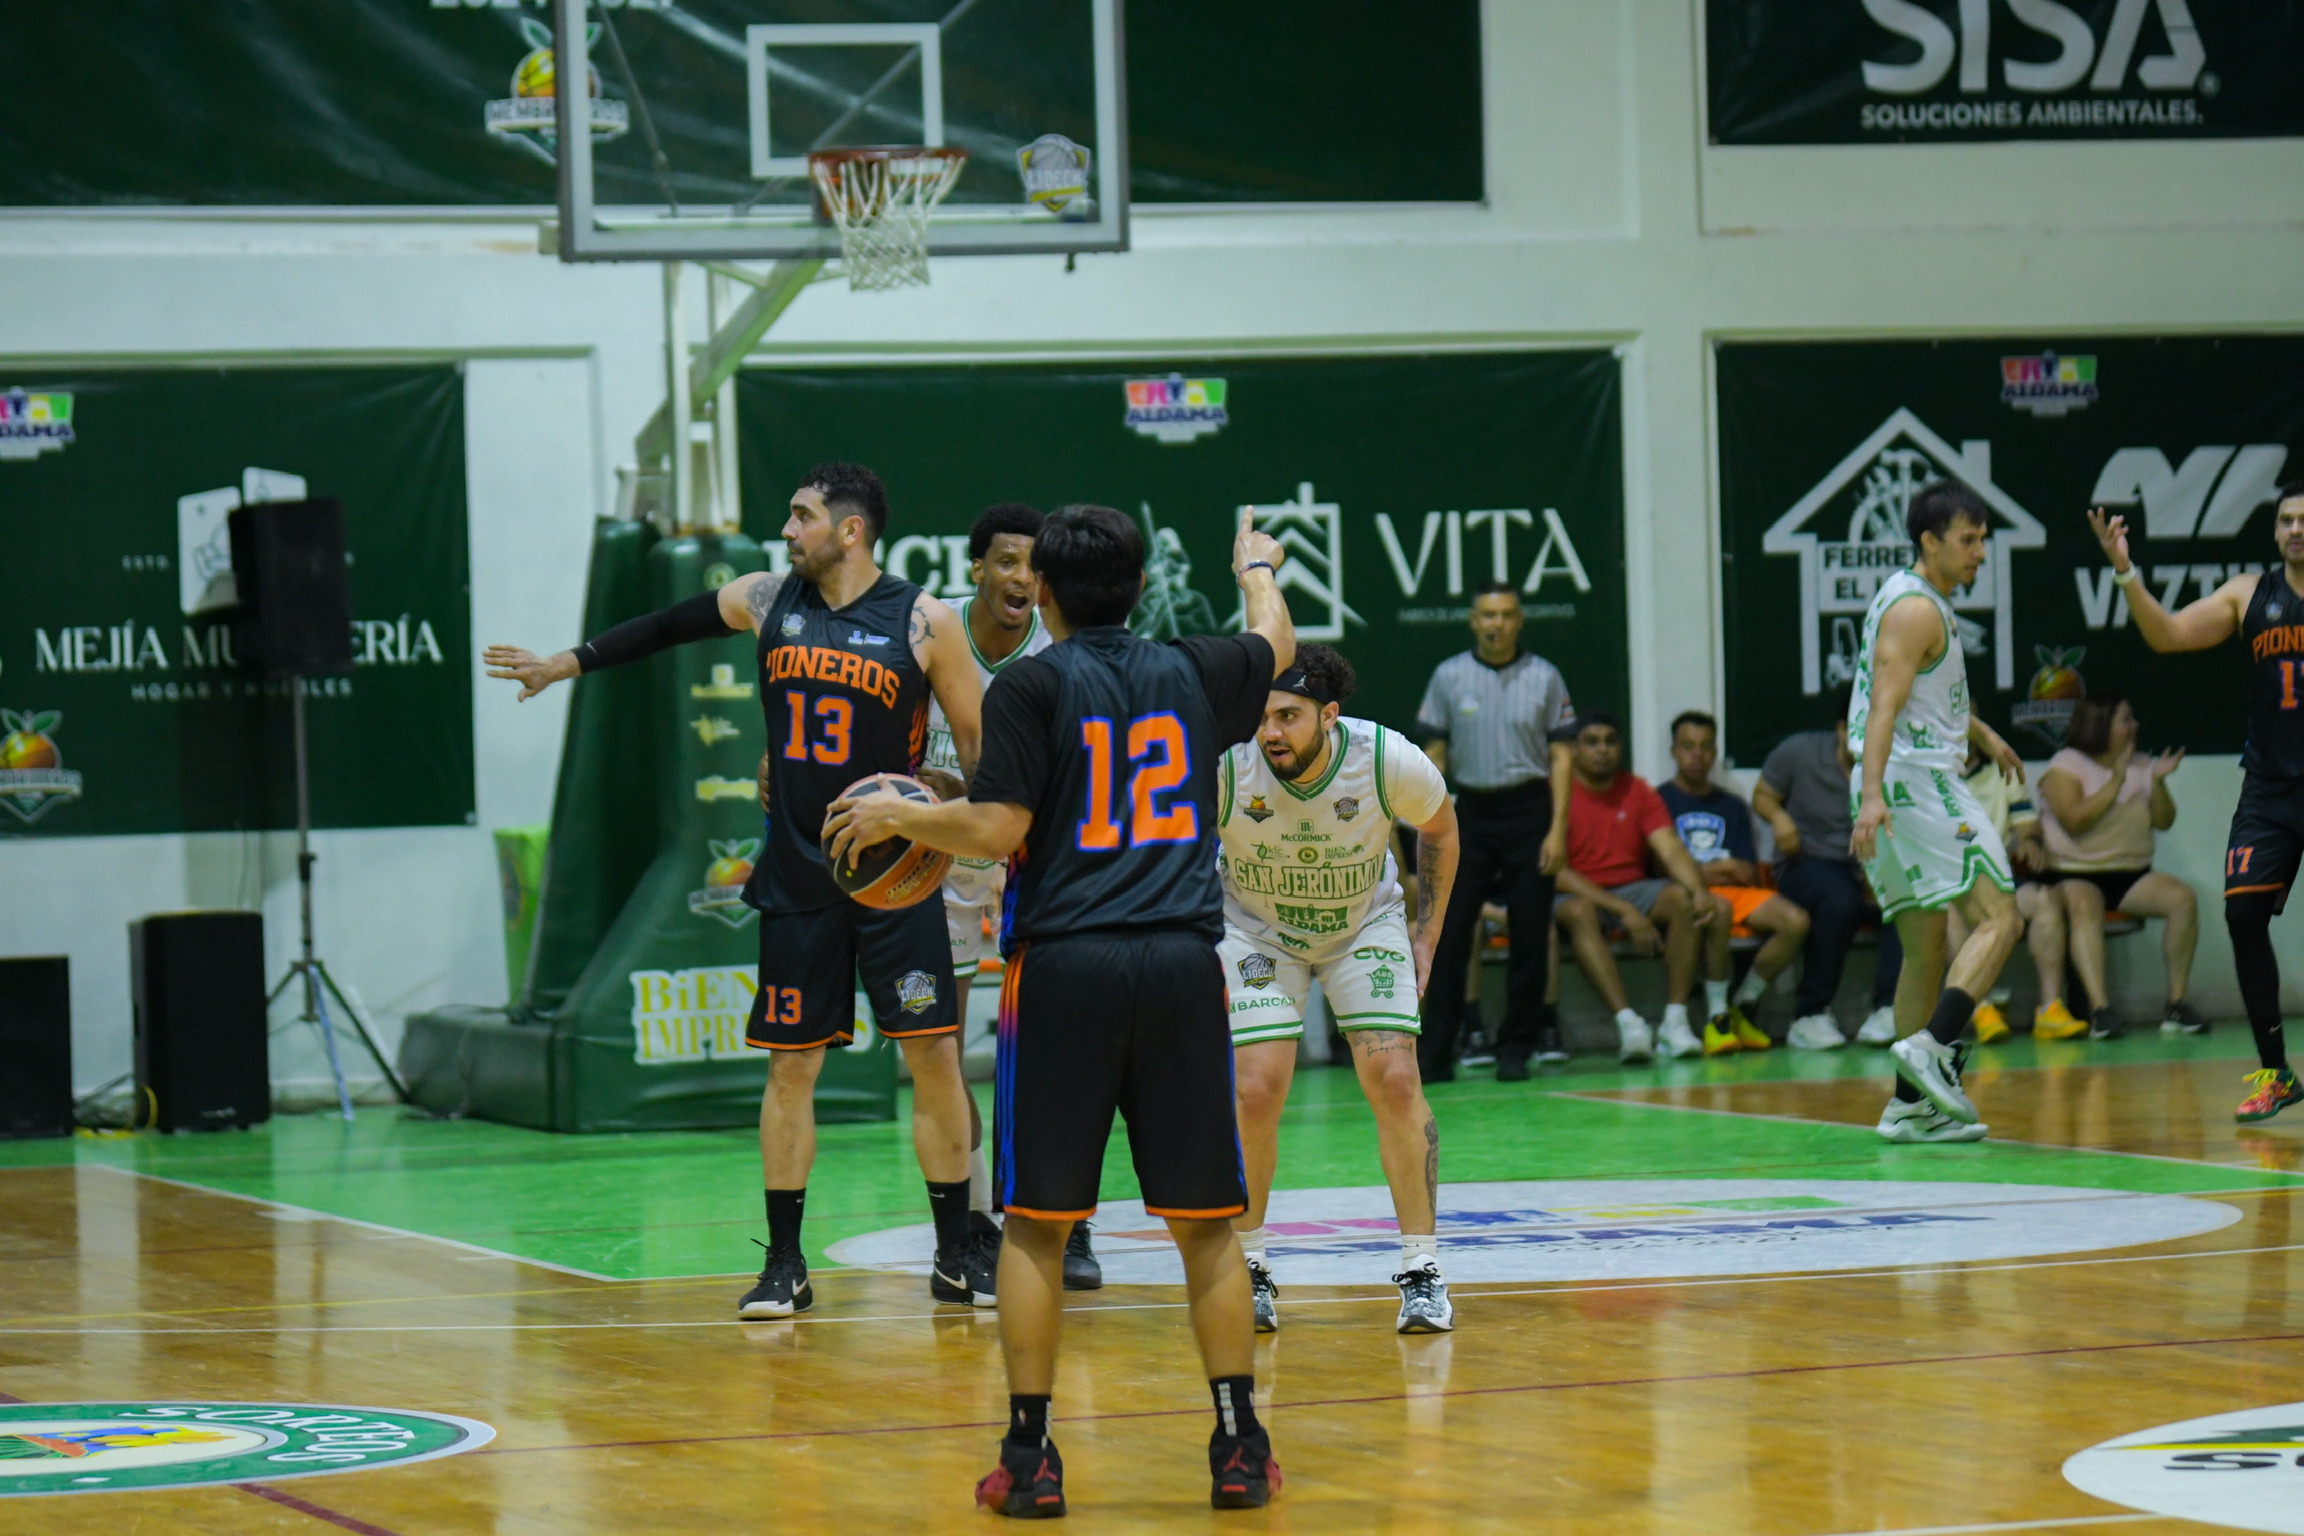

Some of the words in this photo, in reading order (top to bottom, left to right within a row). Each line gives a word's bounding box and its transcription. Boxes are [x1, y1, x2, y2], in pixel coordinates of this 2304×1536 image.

[1862, 0, 2206, 95] SISA
[1861, 102, 2021, 129] SOLUCIONES
[1374, 507, 1592, 597] VITA
[35, 618, 170, 672] MEJÍA
[2279, 660, 2304, 710] 1
[783, 689, 855, 765] 13
[1075, 709, 1199, 853] 12
[1280, 833, 1332, 843] McCORMICK
[2226, 846, 2254, 877] 17
[1234, 857, 1275, 896] SAN
[1277, 853, 1380, 900] JERÓNIMO
[764, 984, 802, 1025] 13
[116, 1406, 417, 1463] SORTEOS
